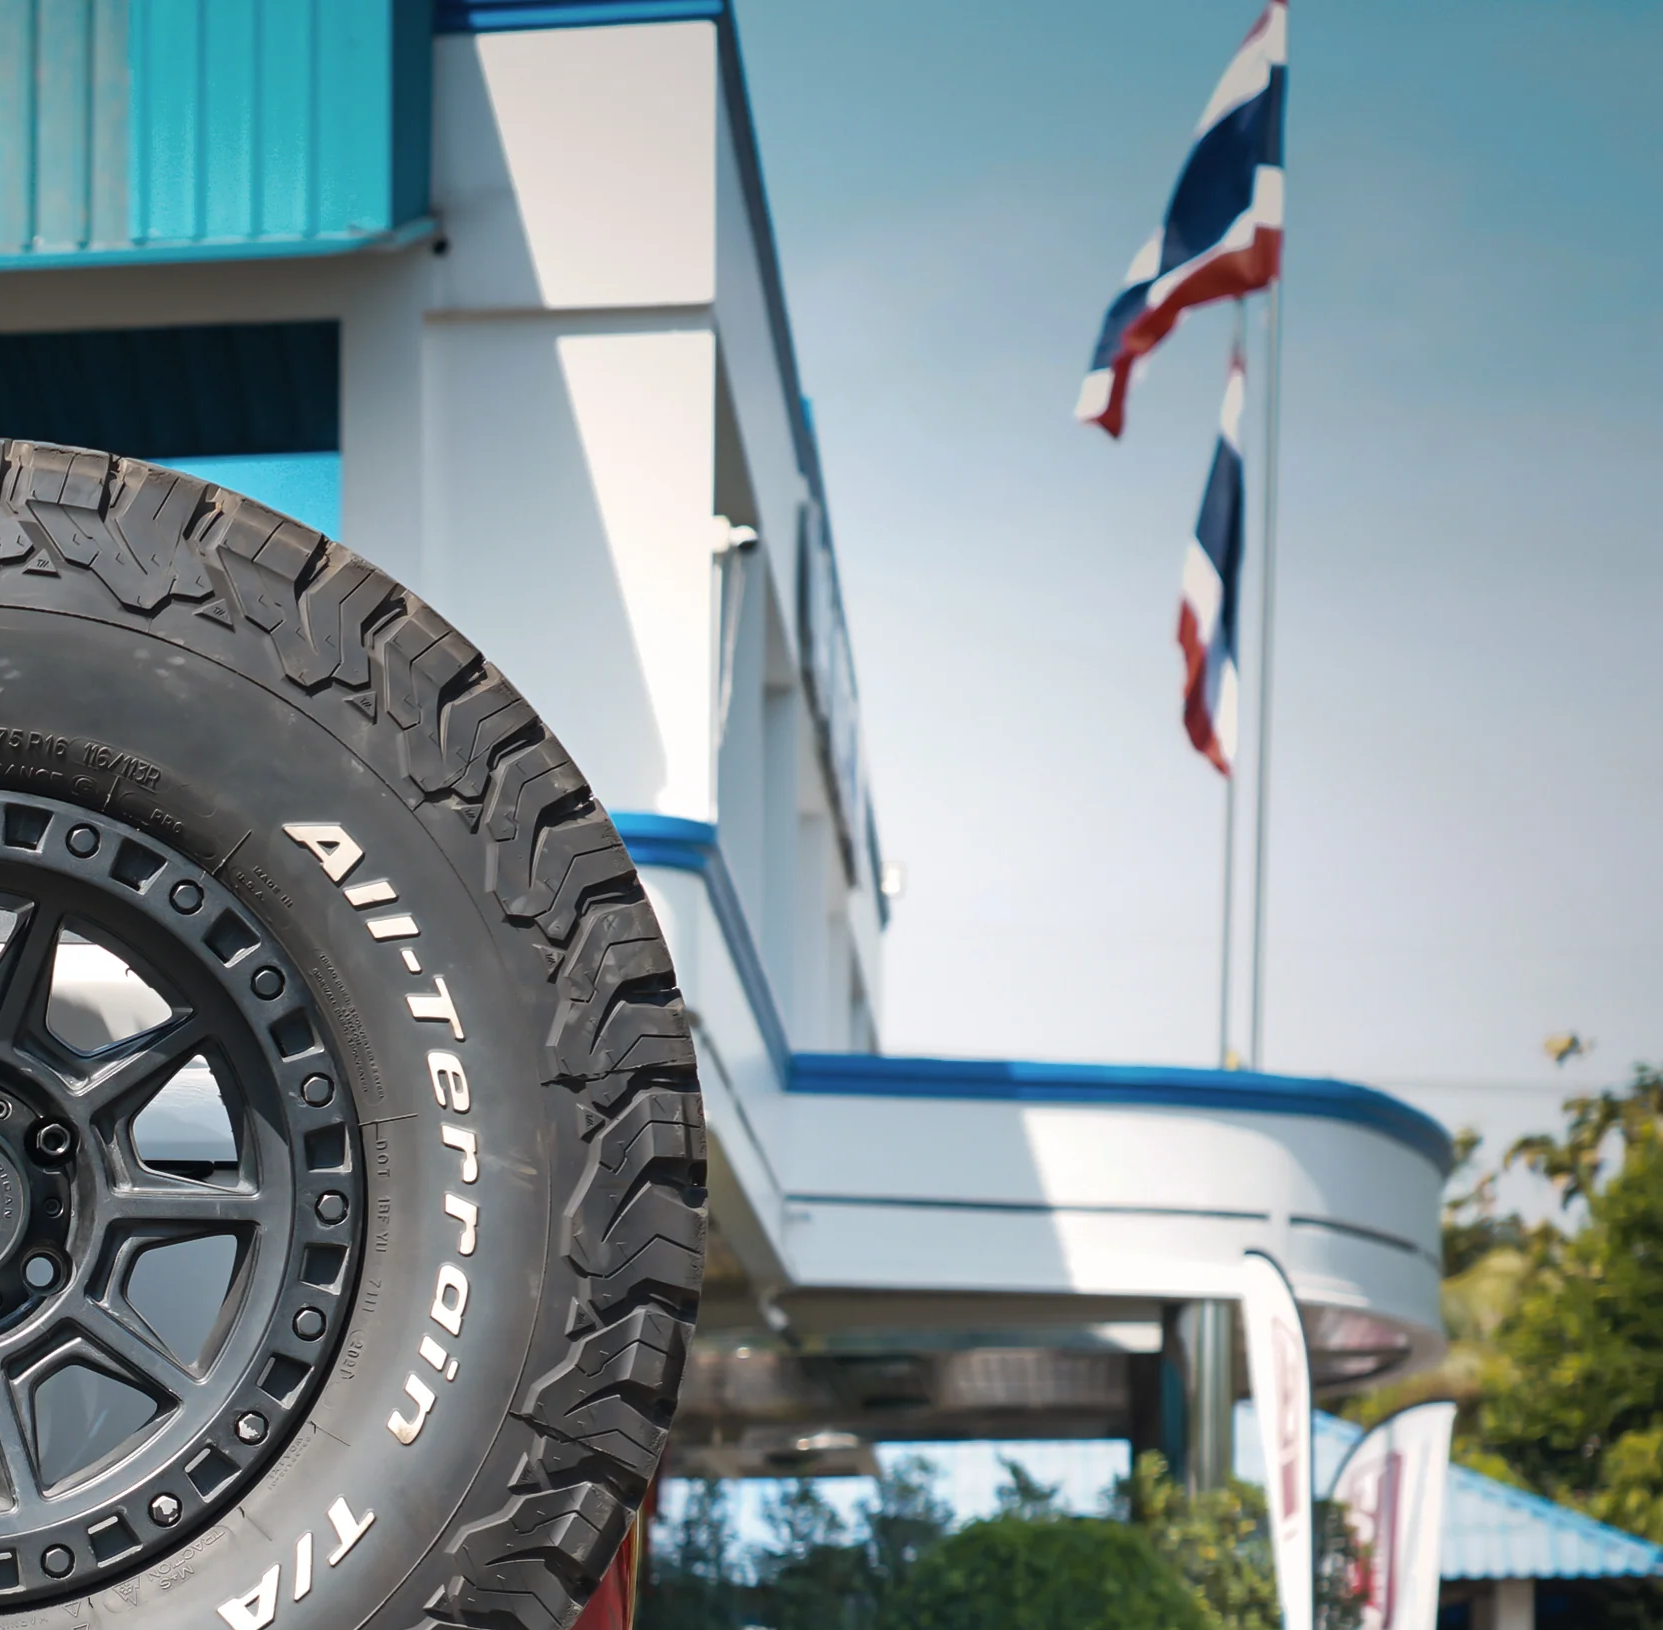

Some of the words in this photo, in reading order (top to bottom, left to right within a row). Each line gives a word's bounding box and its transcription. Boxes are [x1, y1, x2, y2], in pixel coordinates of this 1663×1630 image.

[283, 823, 478, 1445] All-Terrain
[376, 1139, 391, 1178] DOT
[147, 1529, 227, 1582] TRACTION
[159, 1565, 195, 1590] M+S
